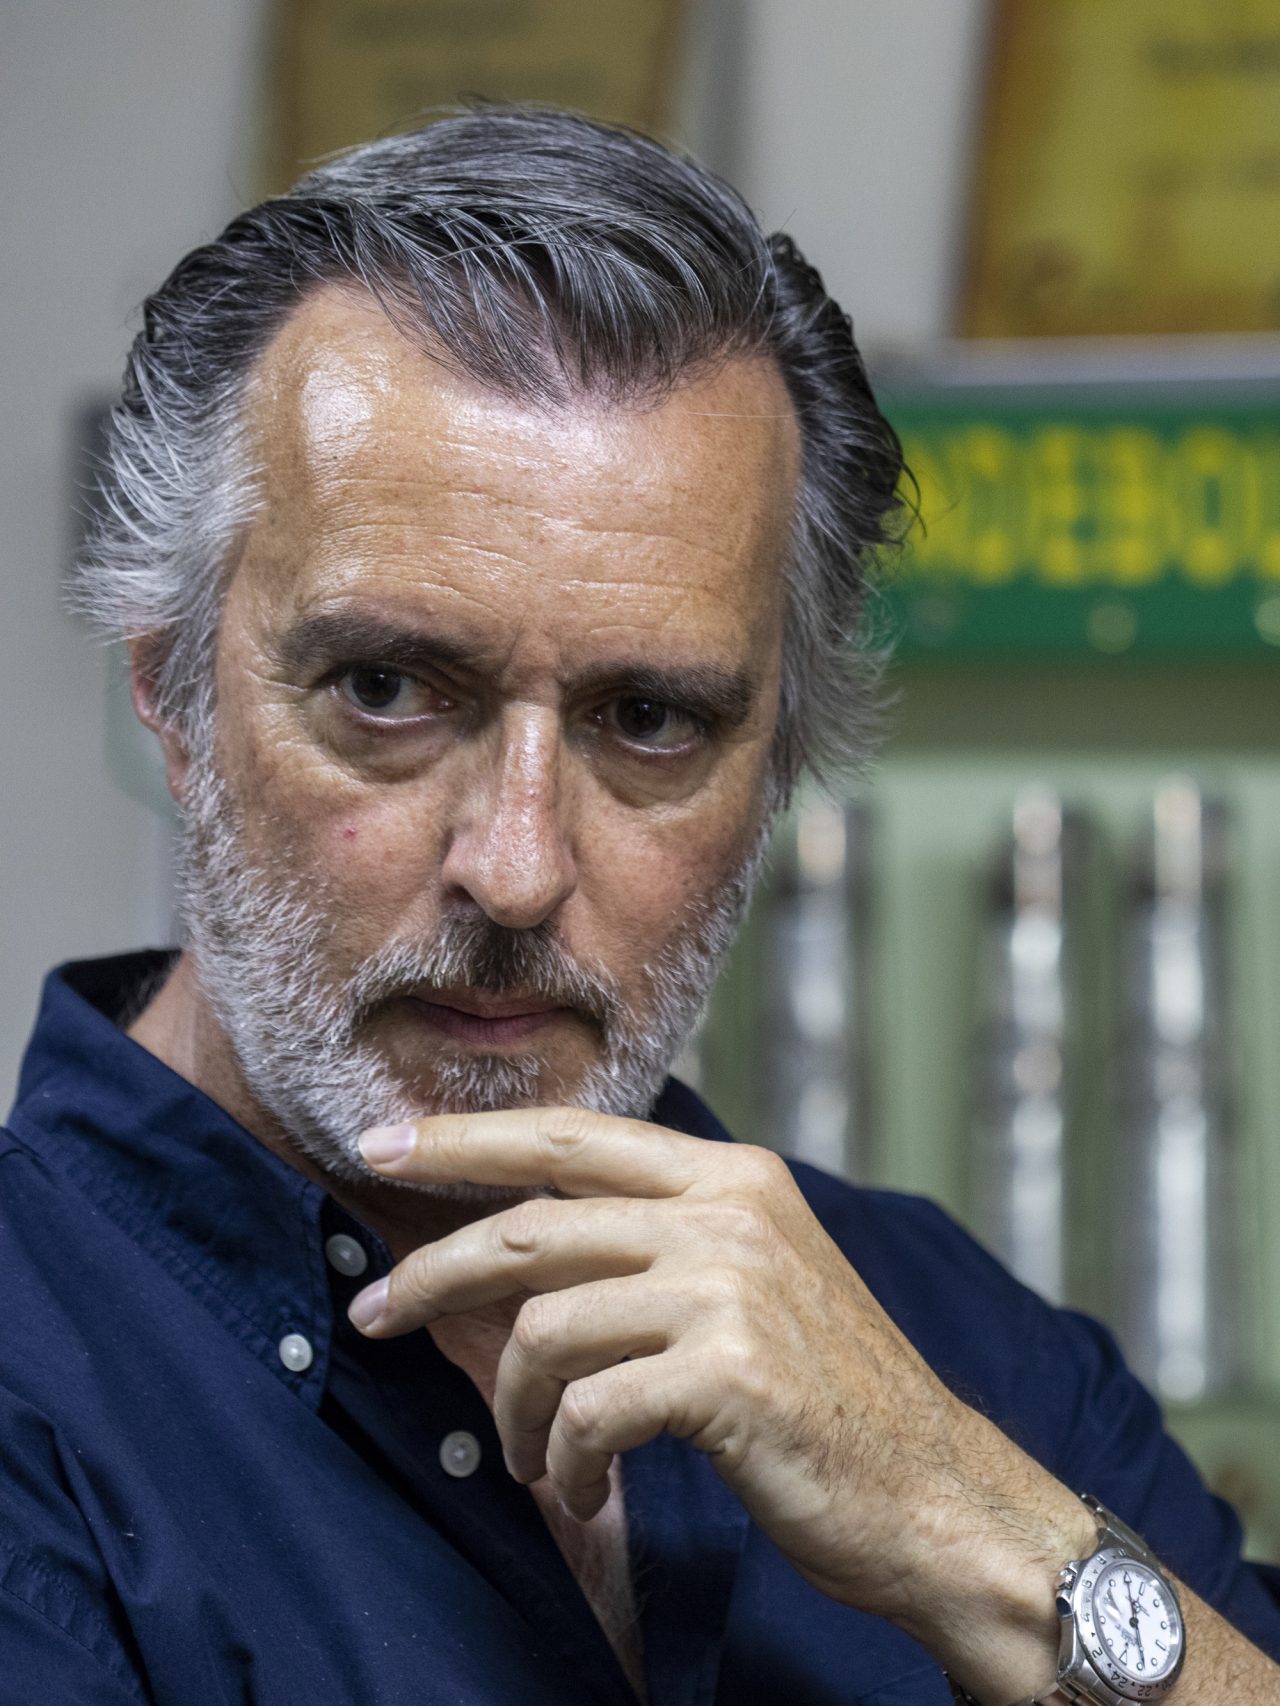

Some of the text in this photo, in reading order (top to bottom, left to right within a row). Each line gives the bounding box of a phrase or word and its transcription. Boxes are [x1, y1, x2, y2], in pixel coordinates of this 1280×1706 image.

[1092, 1647, 1104, 1659] 2
[1110, 1670, 1128, 1689] 24
[1137, 1685, 1153, 1697] 22
